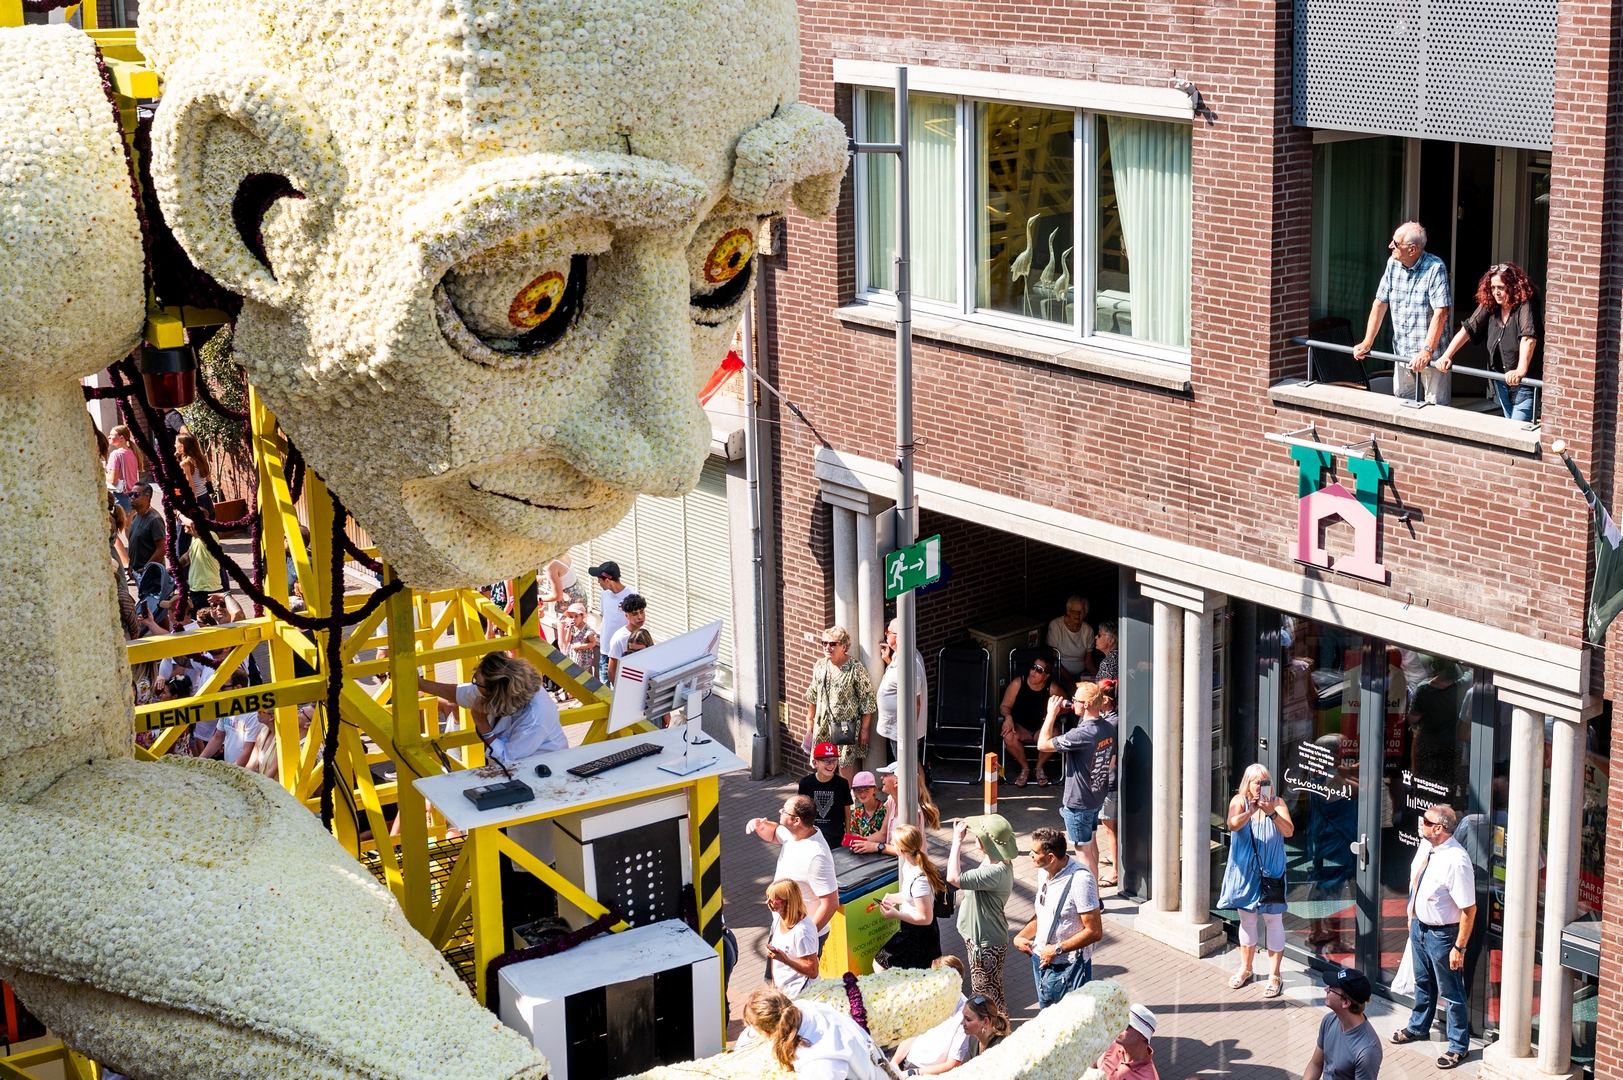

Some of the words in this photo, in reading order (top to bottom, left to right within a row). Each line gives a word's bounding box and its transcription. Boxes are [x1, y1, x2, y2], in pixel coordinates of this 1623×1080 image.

[215, 692, 276, 718] LABS
[1284, 768, 1352, 801] Gewoongoed!
[860, 946, 878, 957] CORSO
